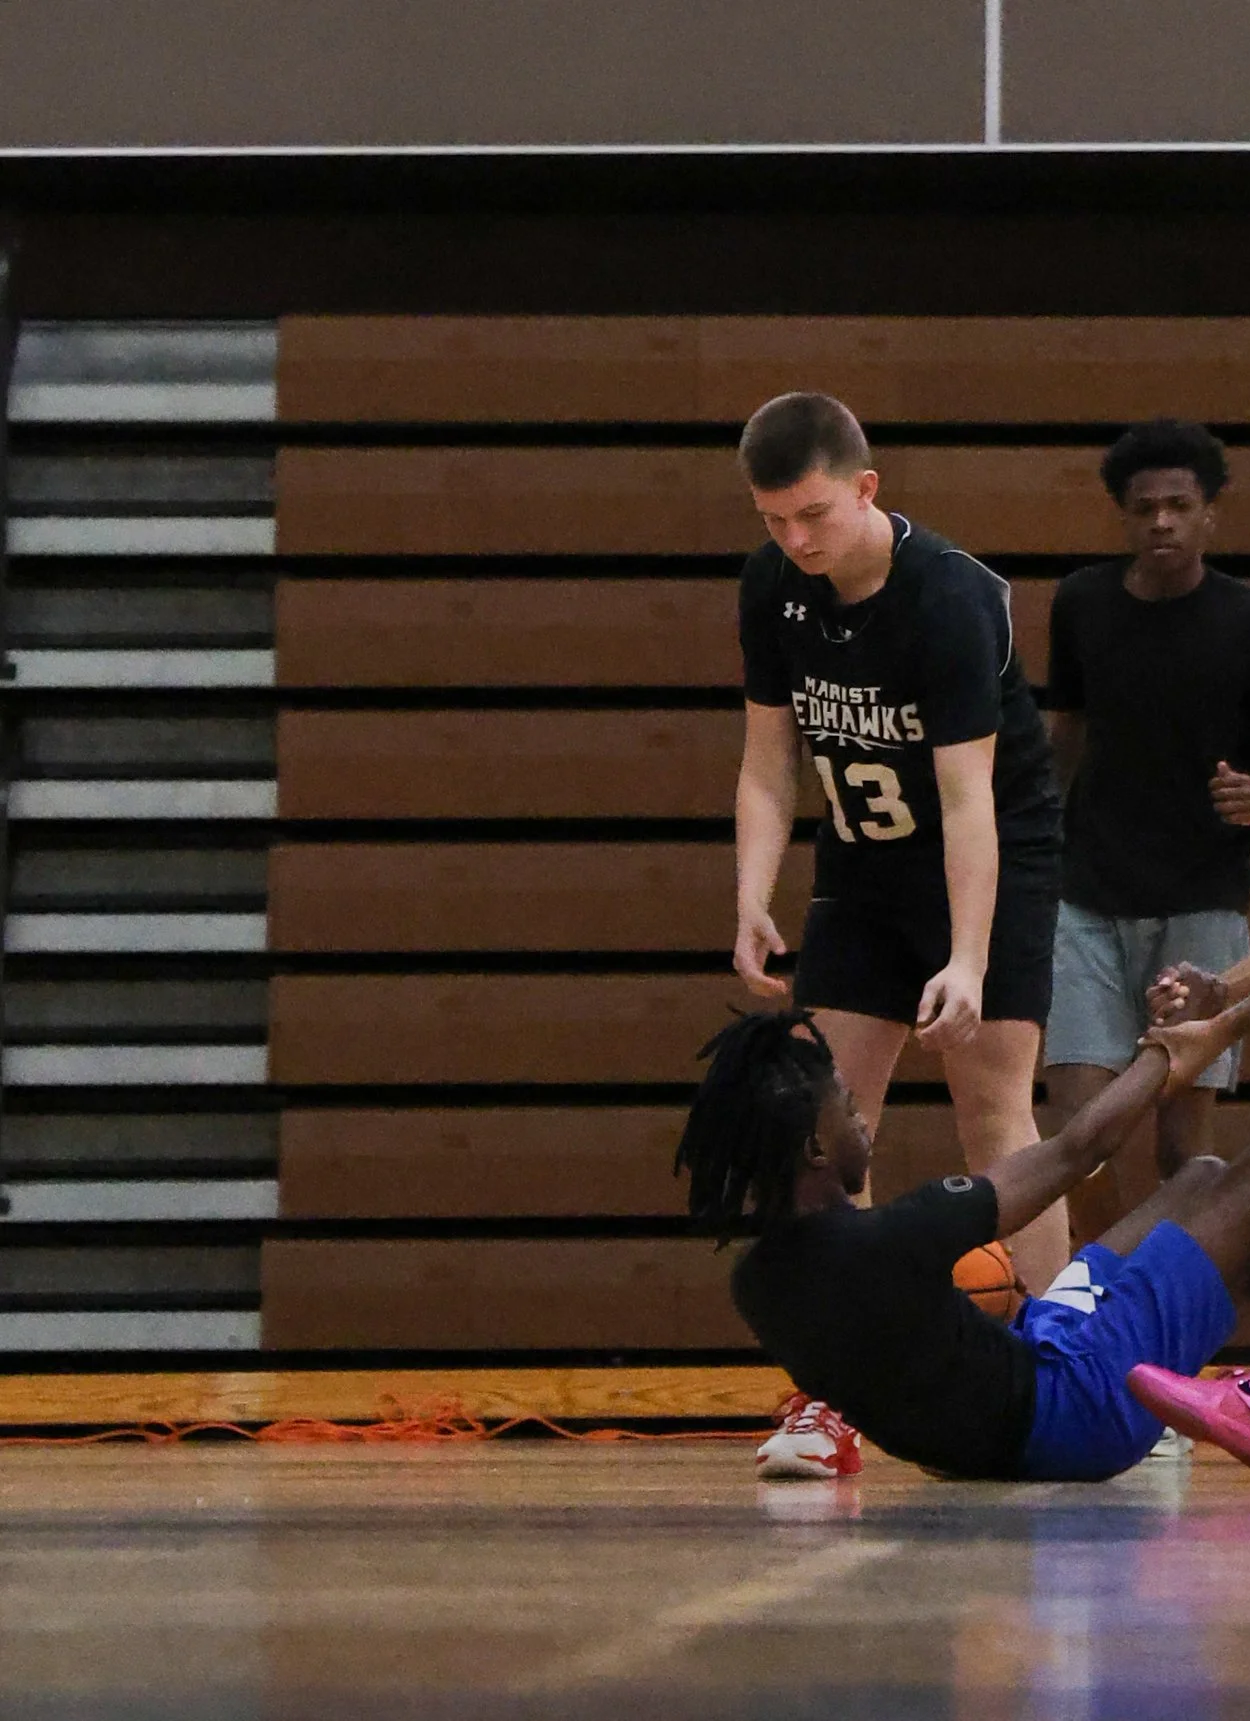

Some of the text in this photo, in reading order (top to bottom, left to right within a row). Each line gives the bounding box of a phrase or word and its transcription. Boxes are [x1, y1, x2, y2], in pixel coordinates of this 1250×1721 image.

[805, 676, 881, 703] MARIST
[791, 690, 925, 742] EDHAWKS
[814, 755, 916, 843] 13
